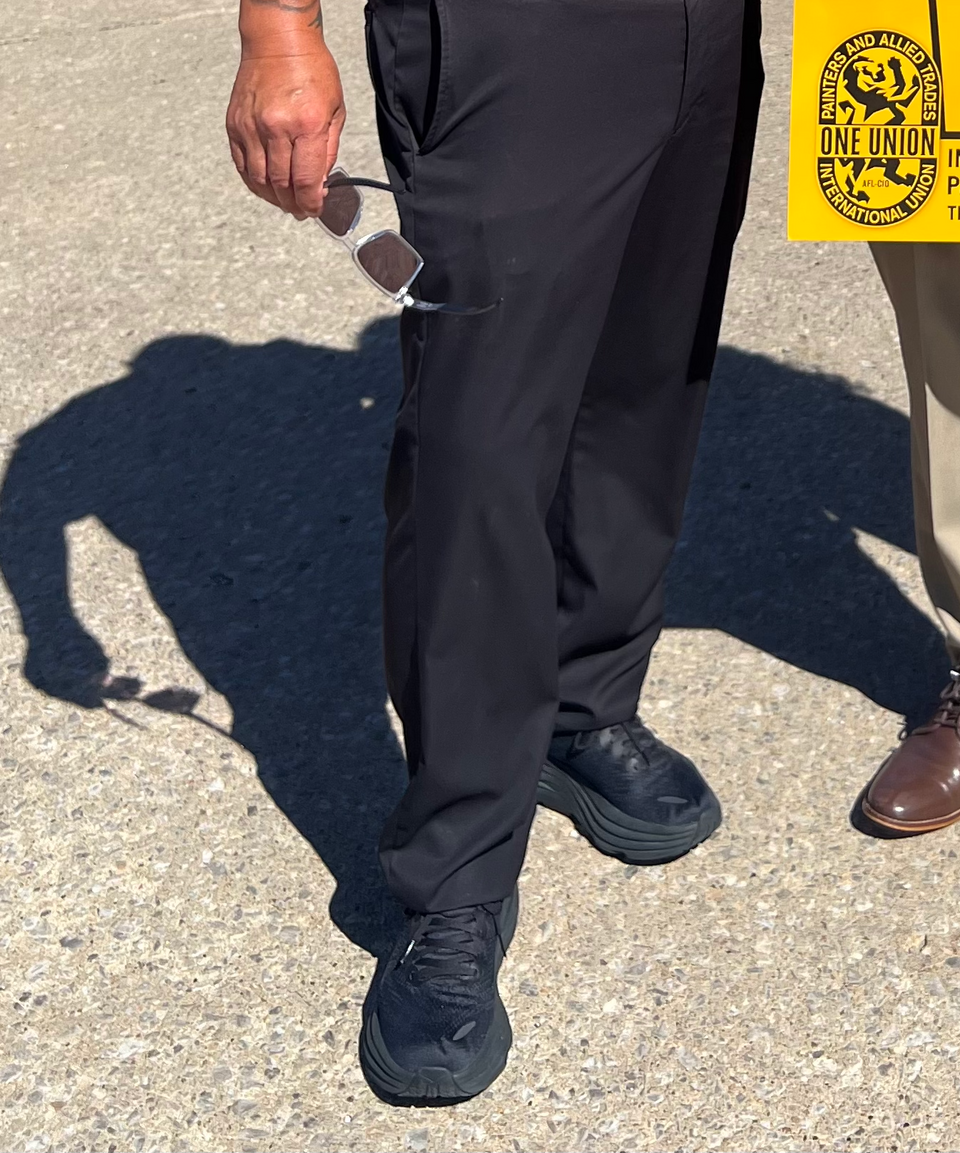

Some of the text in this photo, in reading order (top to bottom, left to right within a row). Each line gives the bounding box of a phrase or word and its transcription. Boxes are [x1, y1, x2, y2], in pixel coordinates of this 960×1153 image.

[821, 33, 938, 122] PAINTERS AND ALLIED TRADES
[820, 126, 936, 157] ONE UNION
[819, 163, 936, 225] INTERNATIONAL UNION
[862, 179, 890, 188] AFL-CIO
